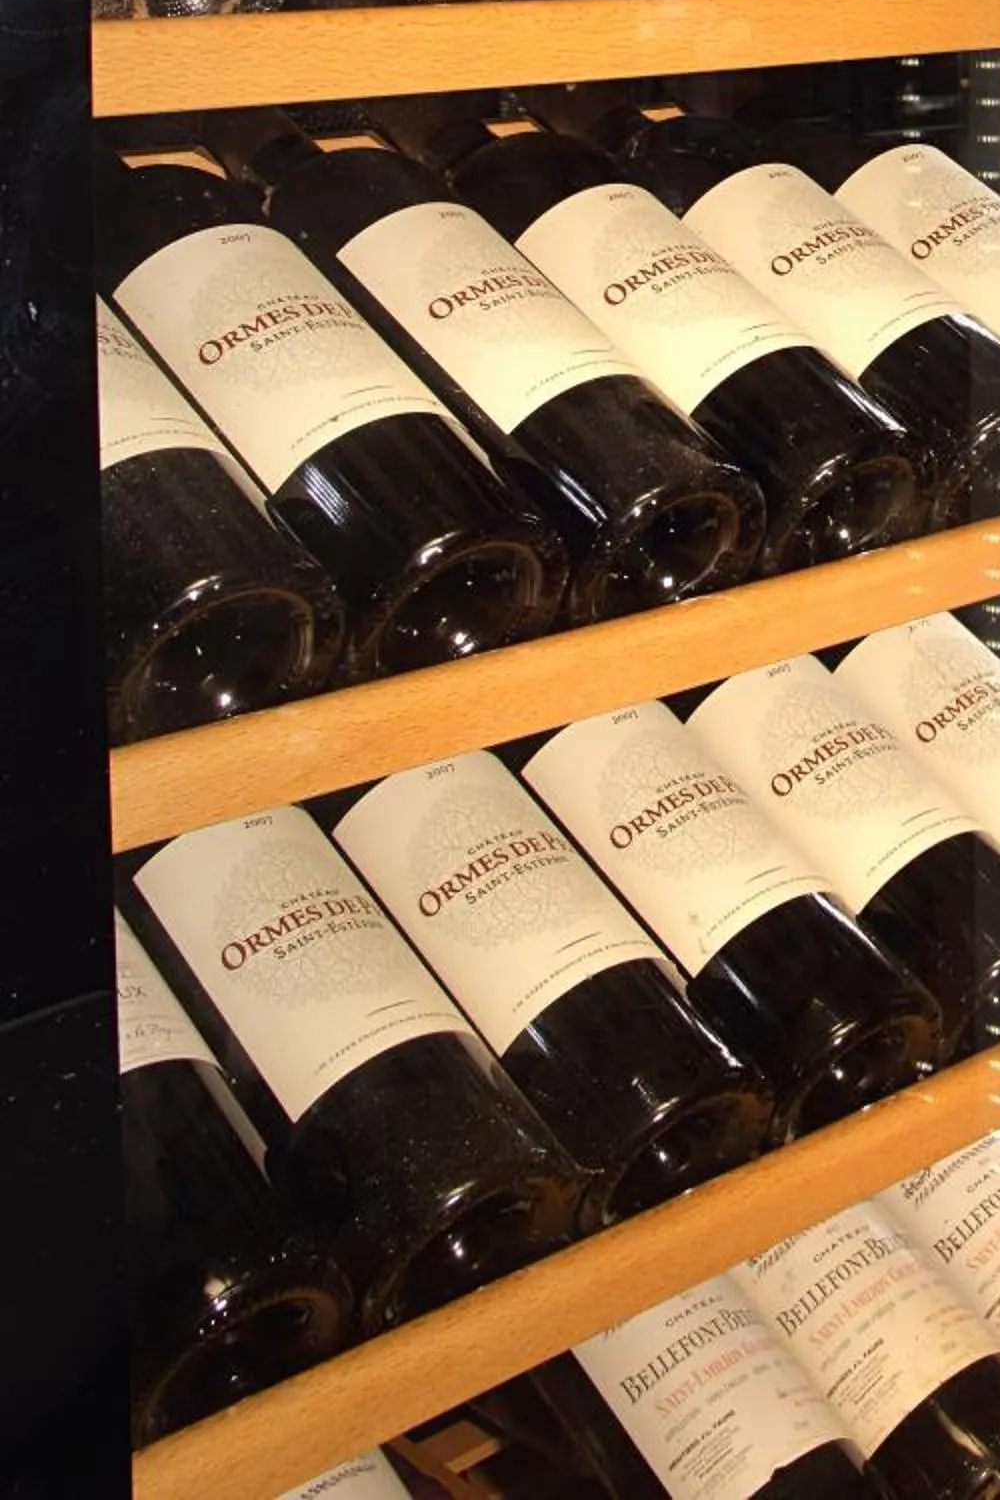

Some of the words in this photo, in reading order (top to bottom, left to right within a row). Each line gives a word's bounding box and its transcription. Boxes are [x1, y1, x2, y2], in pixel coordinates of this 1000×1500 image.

[771, 226, 851, 276] ORMES
[911, 207, 984, 260] ORMES
[428, 274, 522, 319] ORMES
[603, 252, 690, 305] ORMES
[198, 302, 300, 366] ORMES
[915, 681, 989, 745] ORMES
[771, 733, 850, 798] ORMES
[609, 783, 695, 849] ORMES
[418, 845, 510, 918] ORMES
[221, 904, 323, 971] ORMES
